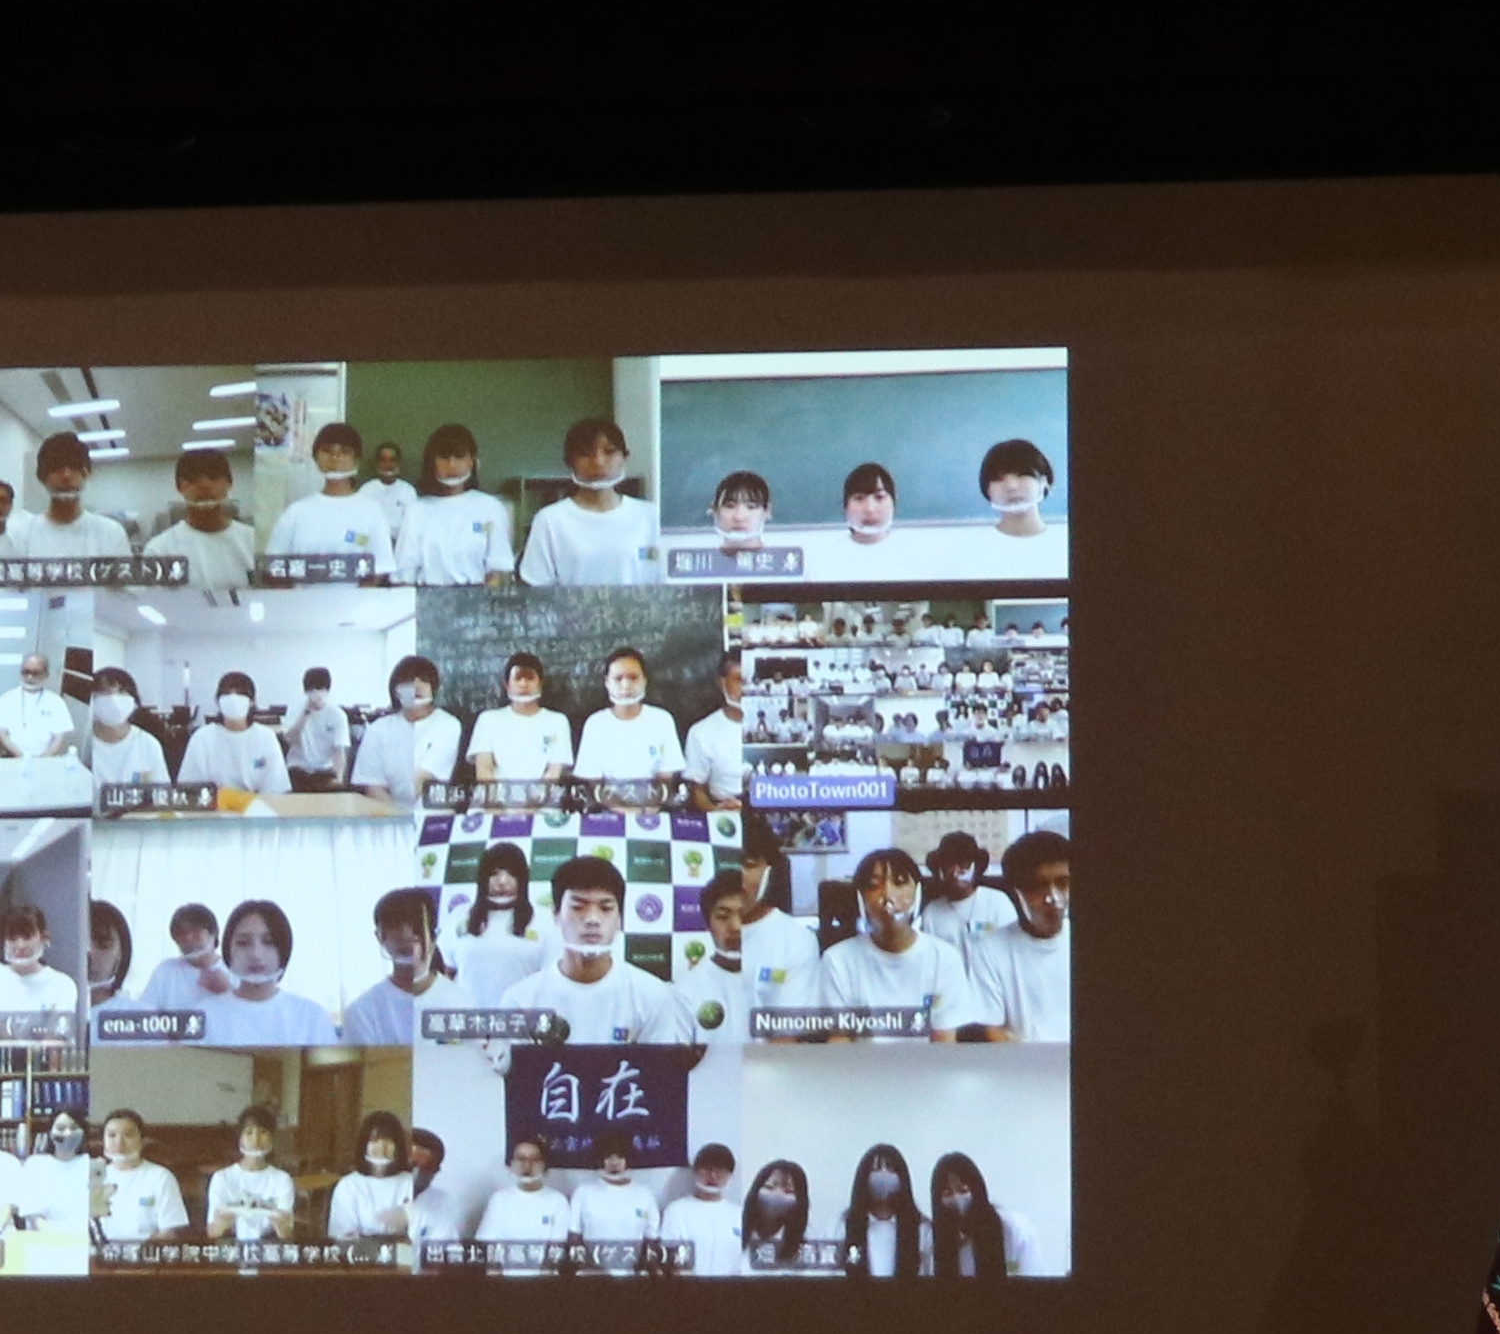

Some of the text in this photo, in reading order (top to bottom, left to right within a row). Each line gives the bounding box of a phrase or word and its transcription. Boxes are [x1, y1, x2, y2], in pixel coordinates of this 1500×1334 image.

[756, 780, 888, 801] PhotoTown001
[103, 1014, 178, 1033] ena-t001
[755, 1012, 904, 1033] Nunome Kiyoshi
[540, 1059, 651, 1124] 自在
